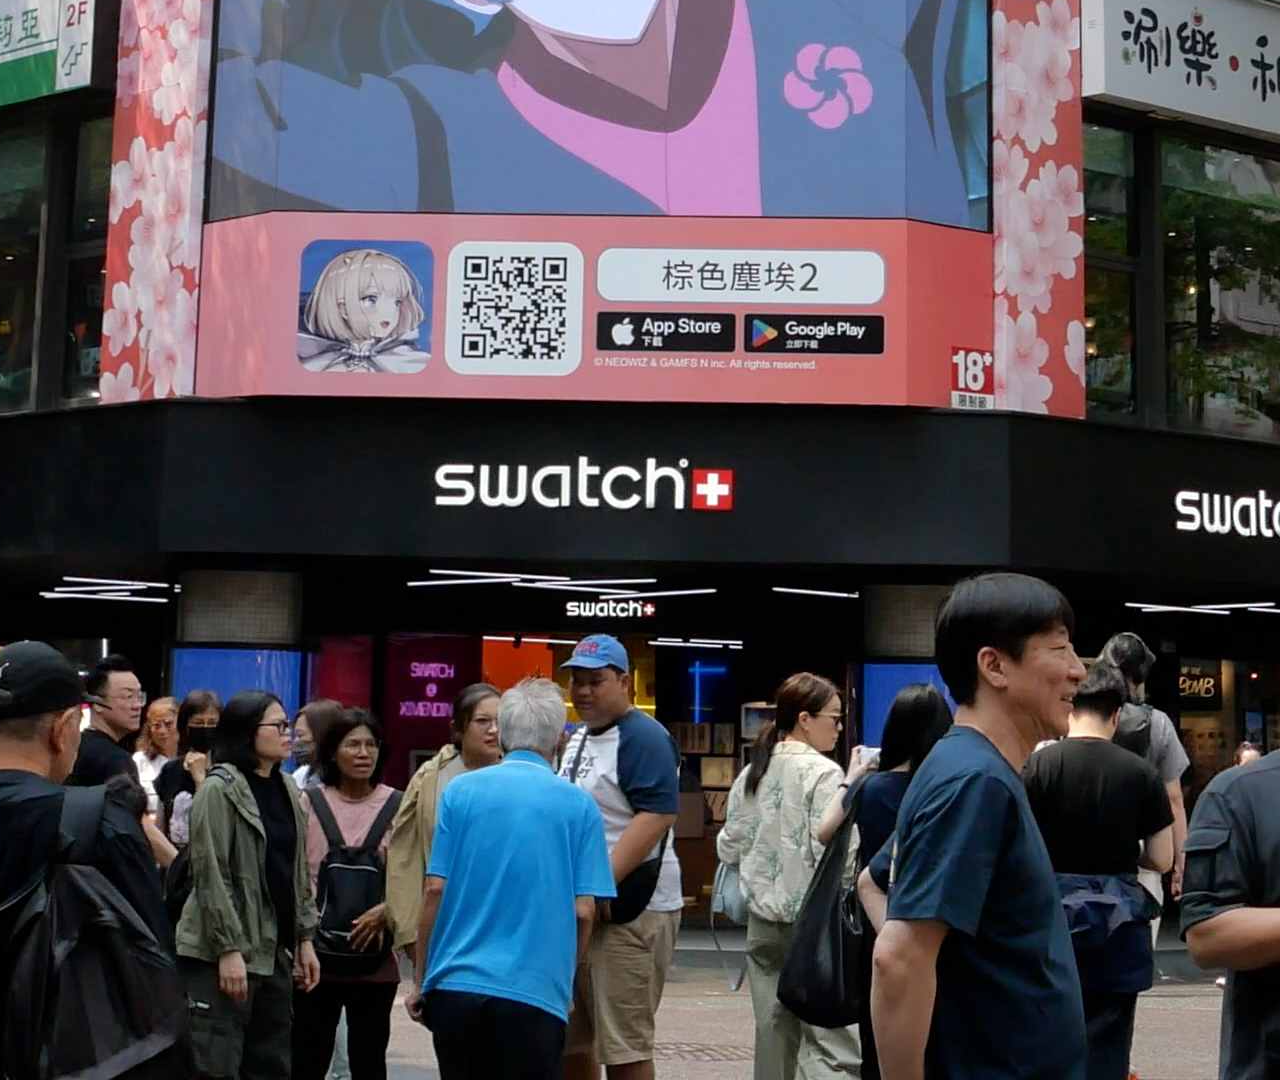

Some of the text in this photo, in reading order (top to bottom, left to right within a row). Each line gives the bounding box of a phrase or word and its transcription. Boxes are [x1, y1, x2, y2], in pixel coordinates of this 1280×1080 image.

[65, 0, 89, 28] 2F
[662, 260, 820, 293] 棕色塵埃2
[642, 318, 721, 336] App Store
[785, 321, 867, 340] Google Play
[605, 357, 649, 368] NEOWIZ
[434, 456, 688, 510] swatch
[566, 600, 643, 619] swatch
[410, 662, 455, 678] SWATCH
[399, 701, 453, 718] XIMENDIN
